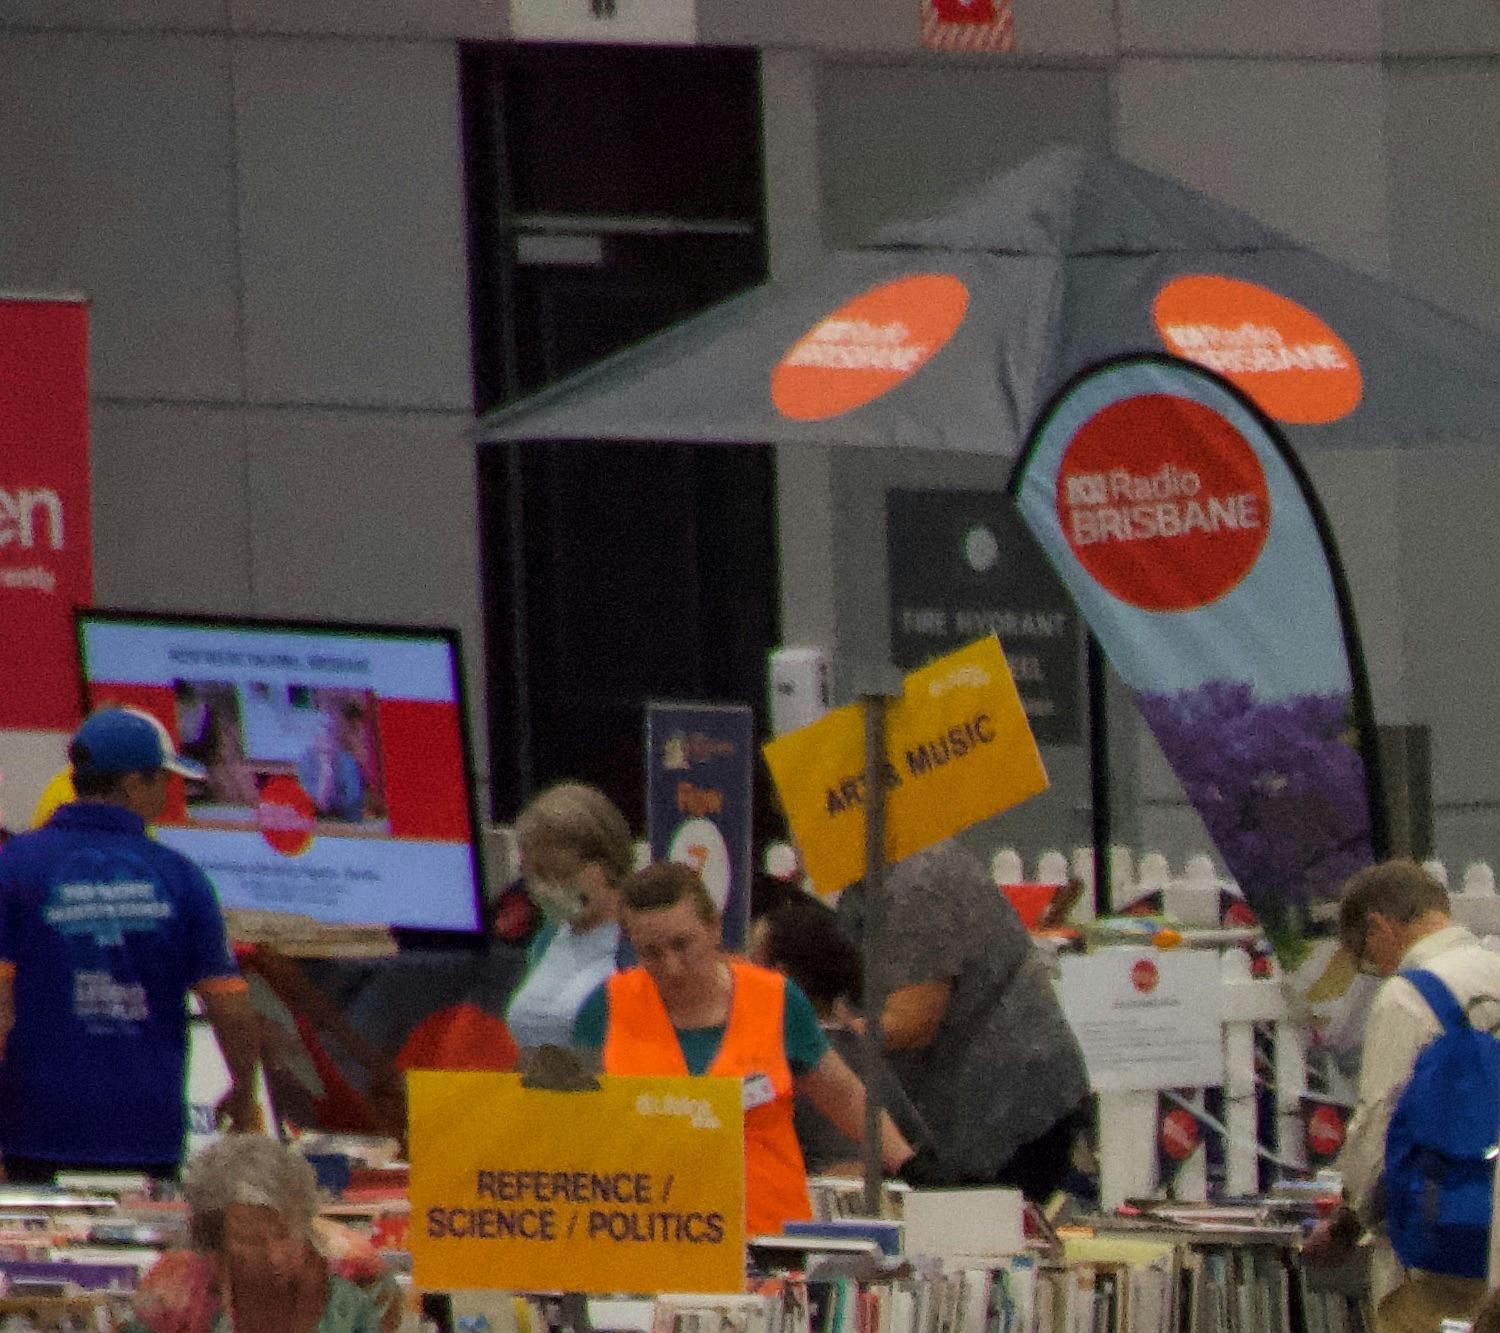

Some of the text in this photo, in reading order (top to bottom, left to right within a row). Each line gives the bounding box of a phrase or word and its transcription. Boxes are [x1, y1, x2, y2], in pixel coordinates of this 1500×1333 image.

[1109, 463, 1201, 499] Radio
[1072, 492, 1260, 546] BRISBANE
[905, 713, 997, 777] MUSIC
[476, 1169, 652, 1203] REFERENCE
[426, 1206, 556, 1241] SCIENCE
[588, 1210, 725, 1244] POLITICS
